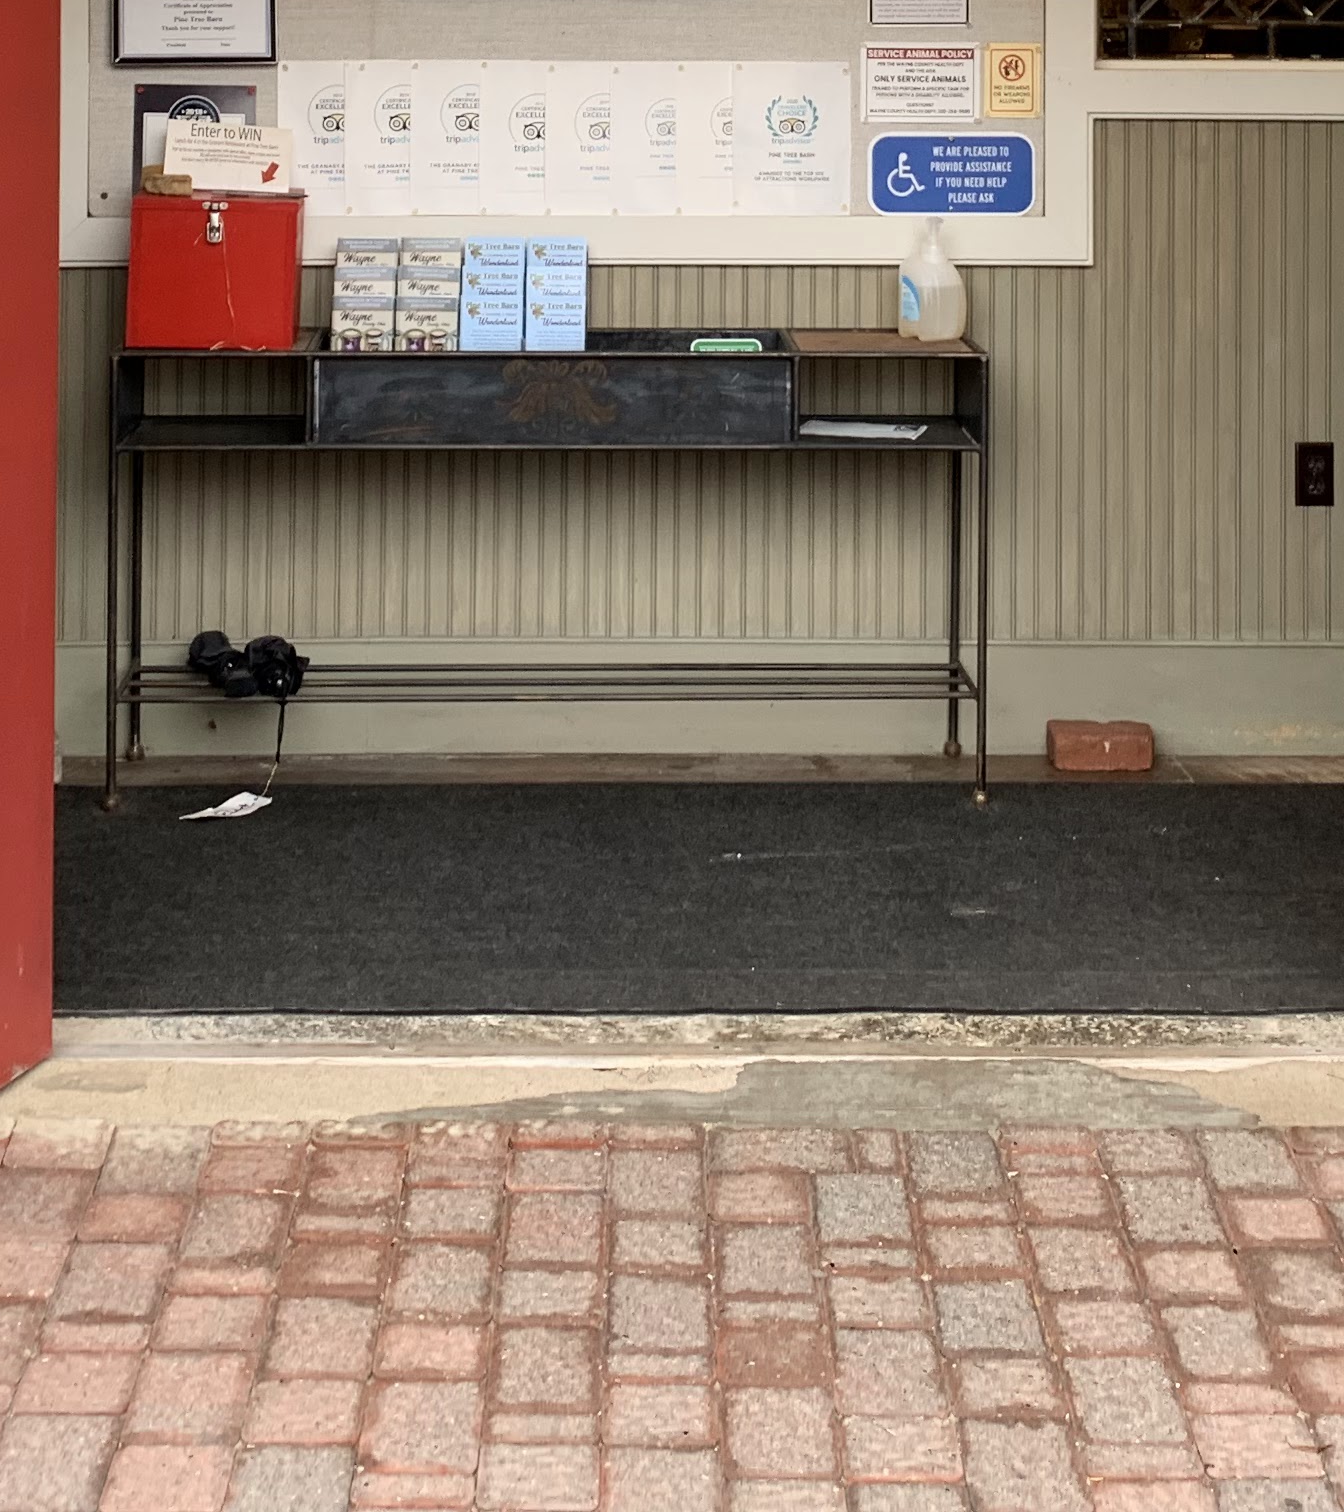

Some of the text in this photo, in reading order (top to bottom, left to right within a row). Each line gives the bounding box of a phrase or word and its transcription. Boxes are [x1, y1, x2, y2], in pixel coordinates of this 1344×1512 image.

[867, 49, 972, 59] SERVICE ANIMAL POLICY
[874, 75, 966, 83] ONLY SERVICE ANIMALS
[191, 124, 262, 142] Enter to WIN
[771, 137, 811, 146] tripadvisor
[932, 146, 1009, 157] WE ARE PLEASED TO
[930, 161, 1012, 172] PROVIDE ASSISTANCE
[935, 177, 1007, 188] IF YOU NEED HELP
[948, 192, 994, 203] PLEASE ASK
[344, 252, 376, 265] Wayne
[409, 252, 441, 265] Wayne
[340, 281, 374, 295] Wayne
[407, 280, 440, 295] Wayne
[565, 302, 582, 310] Barn
[339, 310, 373, 325] Wayne
[405, 310, 437, 326] Wayne
